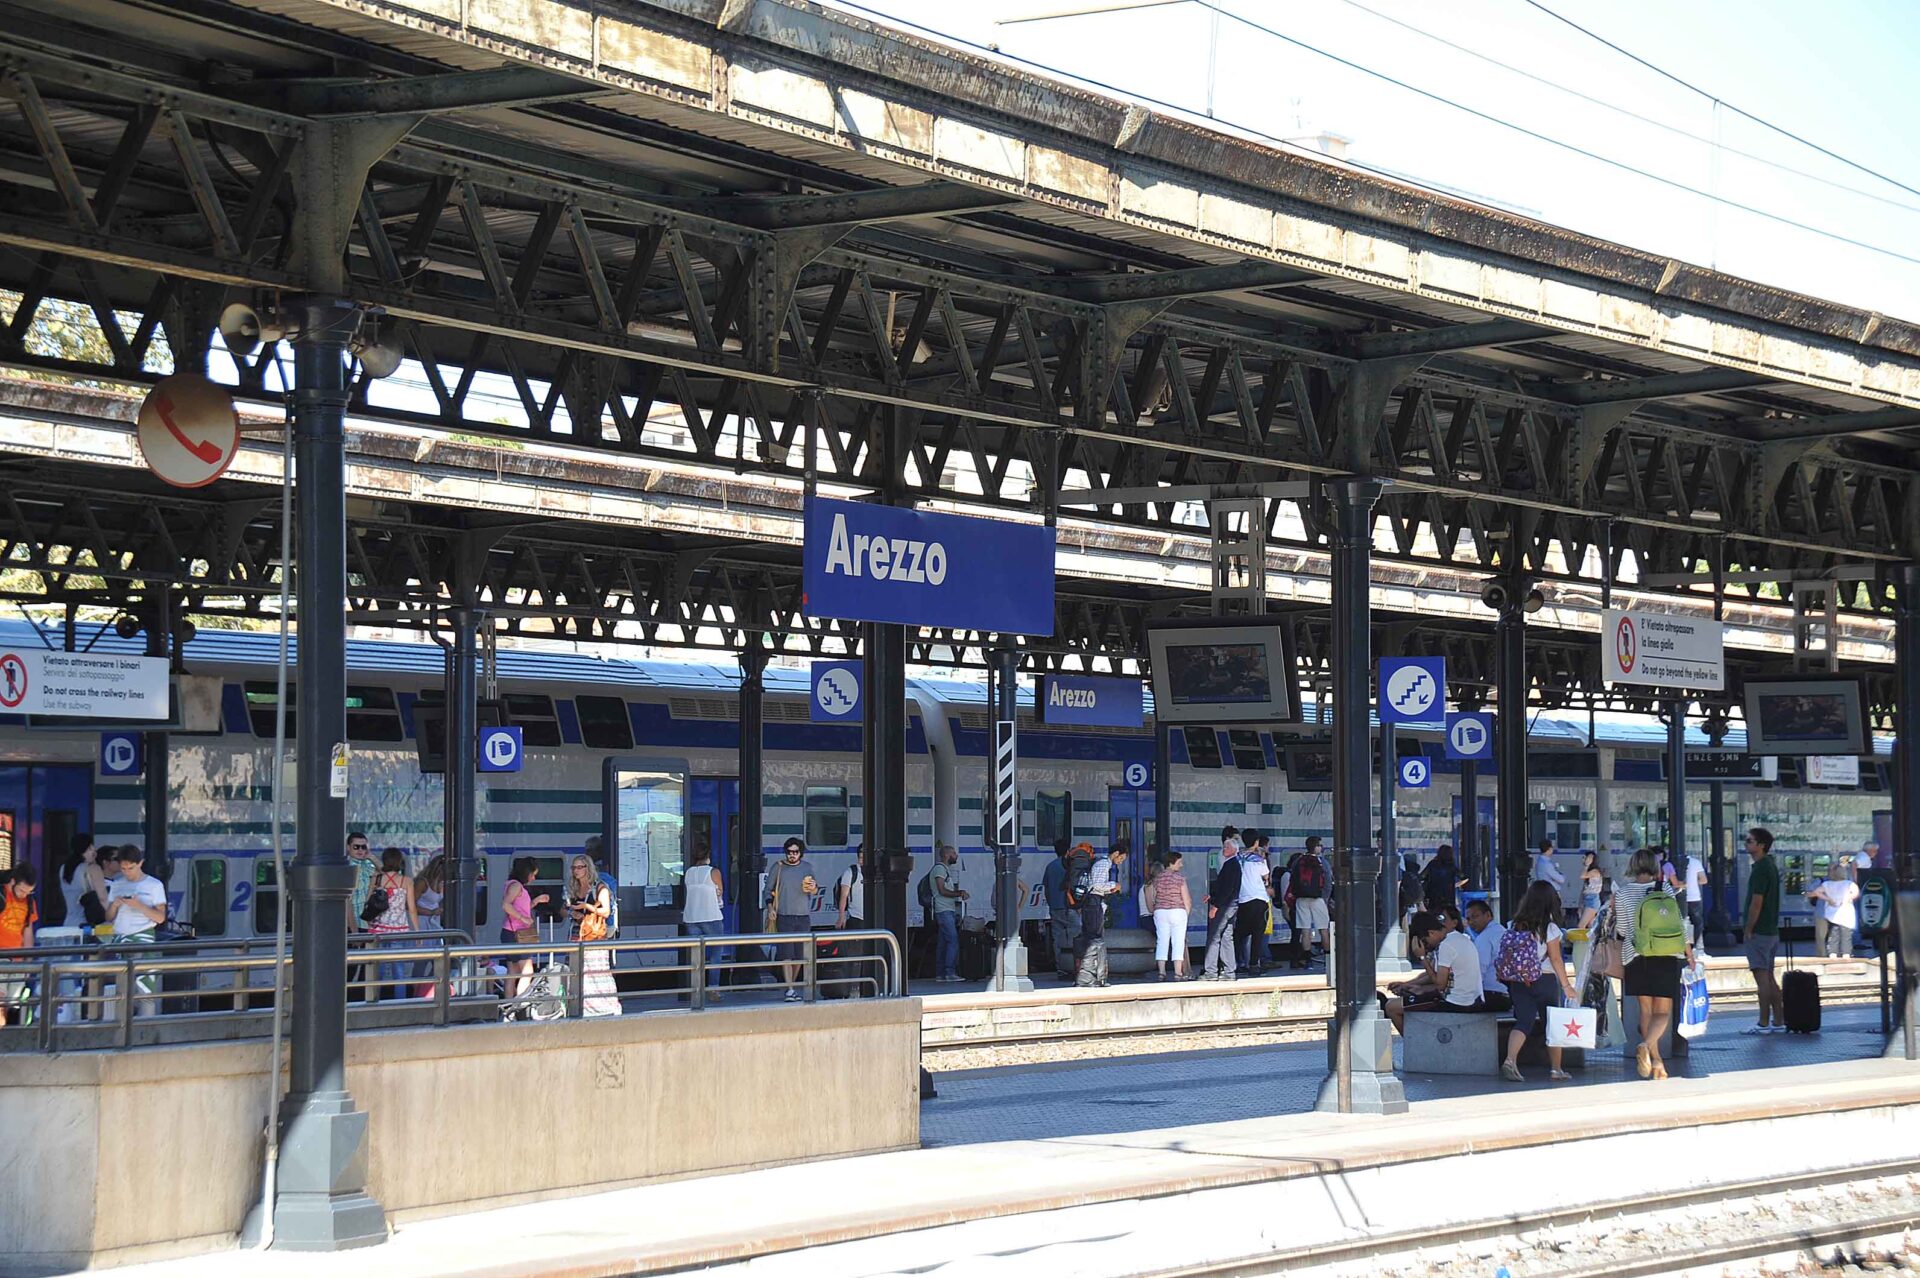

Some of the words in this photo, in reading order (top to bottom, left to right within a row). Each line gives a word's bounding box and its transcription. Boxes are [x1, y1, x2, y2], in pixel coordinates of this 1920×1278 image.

[824, 513, 947, 586] Arezzo
[1647, 619, 1664, 631] Vietato
[1664, 621, 1695, 636] oltrepassare
[1641, 635, 1647, 647] la
[1647, 637, 1660, 649] linea
[1660, 638, 1674, 651] gialla
[43, 655, 69, 667] Vietato
[71, 657, 114, 669] attraversare
[120, 659, 141, 670] binari
[1641, 663, 1649, 674] Do
[1649, 665, 1659, 676] not
[1659, 667, 1666, 679] go
[1666, 665, 1684, 680] beyond
[1684, 667, 1693, 679] the
[1693, 668, 1708, 682] yellow
[1709, 669, 1718, 680] line
[43, 685, 54, 695] Do
[55, 687, 68, 696] not
[68, 688, 87, 697] cross
[87, 687, 100, 698] the
[100, 688, 127, 700] railway
[128, 690, 145, 699] lines
[1049, 681, 1096, 708] Arezzo
[43, 700, 56, 710] Use
[56, 701, 68, 710] the
[68, 701, 92, 711] subway
[1686, 753, 1712, 762] ENZE
[1131, 767, 1143, 783] 5
[1408, 764, 1421, 780] 4
[1751, 762, 1760, 772] 4
[229, 880, 253, 912] 2
